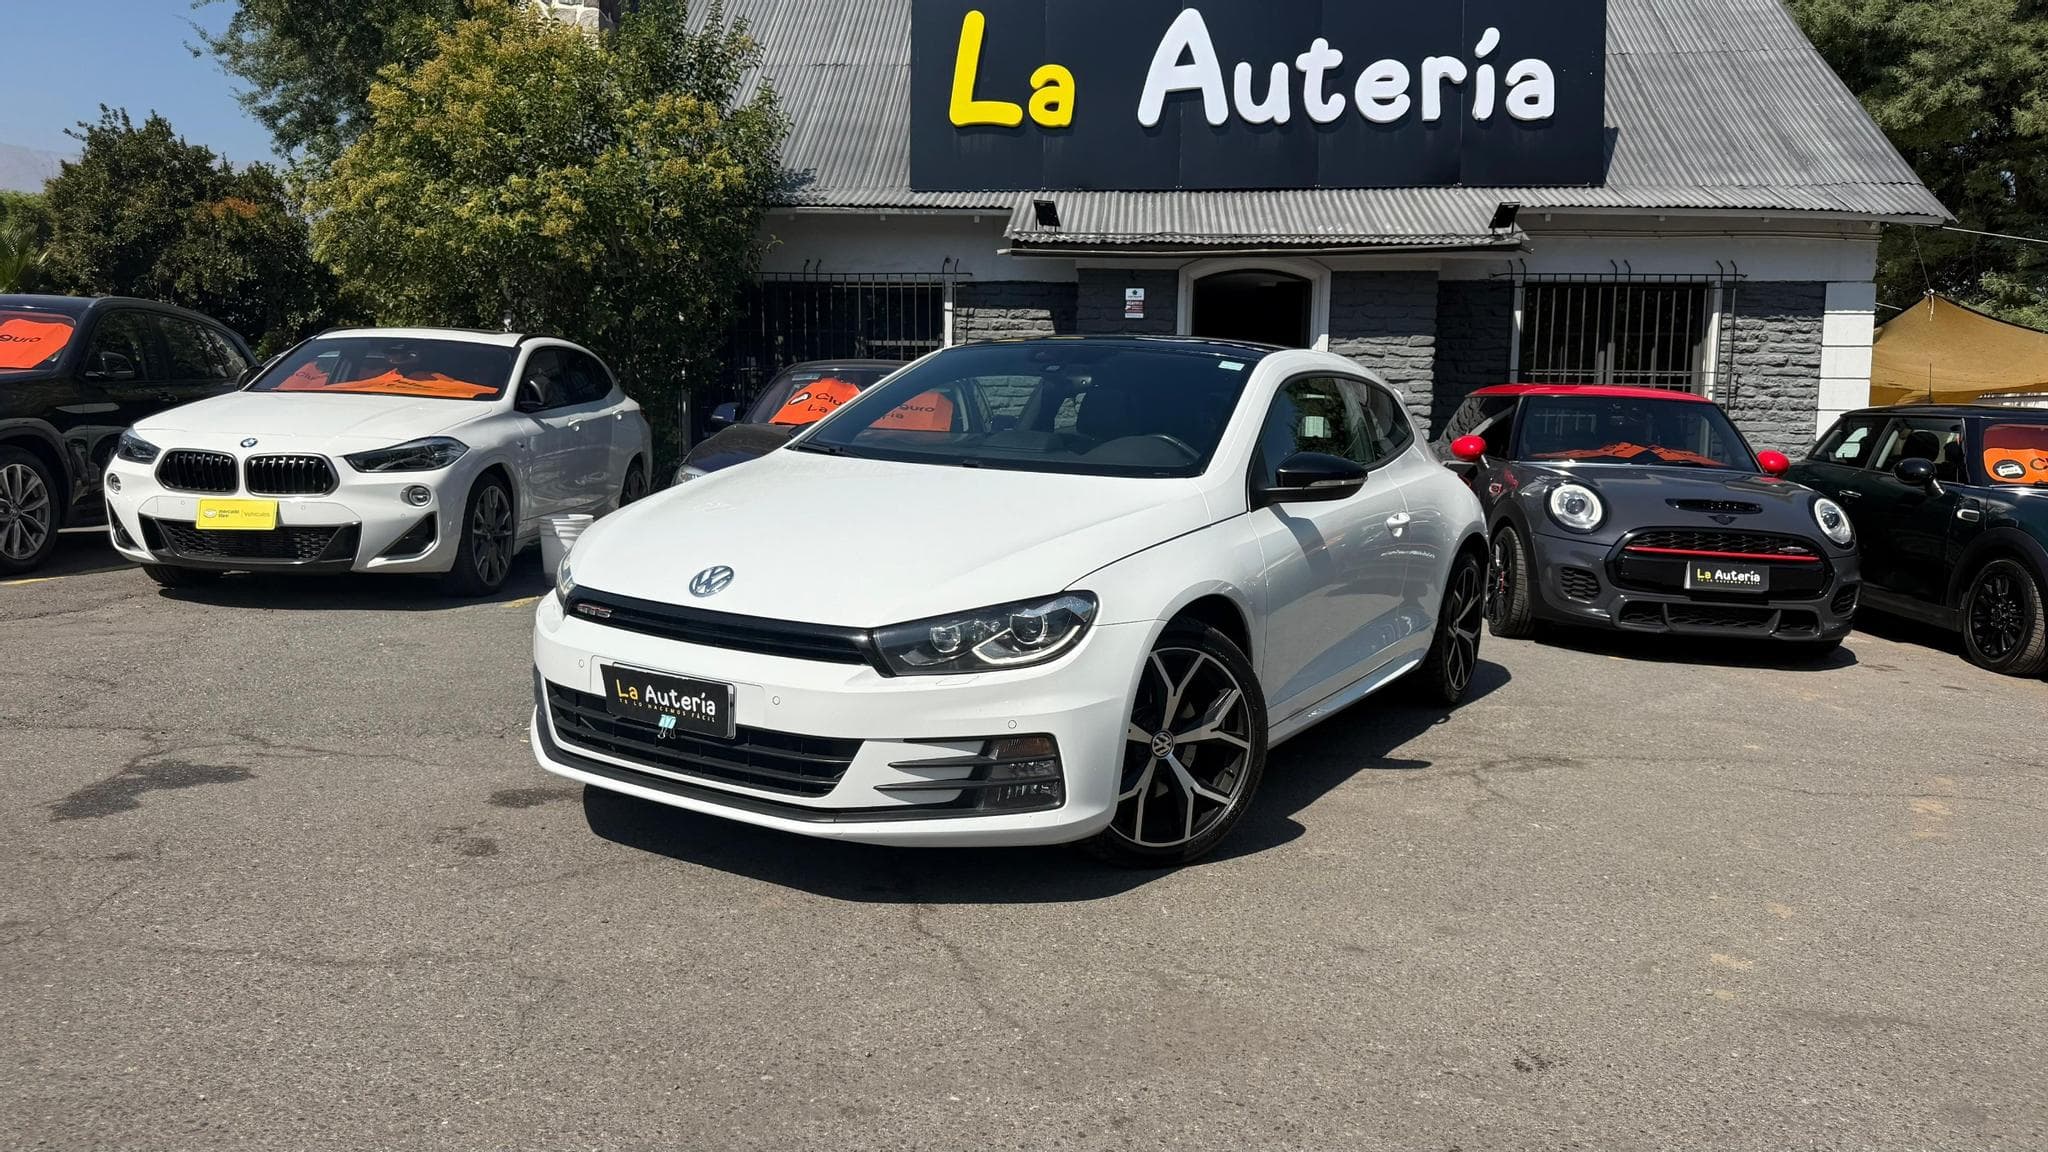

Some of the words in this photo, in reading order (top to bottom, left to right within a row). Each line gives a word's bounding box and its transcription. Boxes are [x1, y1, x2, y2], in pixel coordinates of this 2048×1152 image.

[949, 10, 1076, 128] La
[1137, 8, 1556, 127] Autería
[1696, 567, 1712, 580] La
[1714, 569, 1761, 582] Autería
[616, 679, 639, 701] La
[645, 684, 716, 716] Autería
[647, 704, 687, 717] HACEMOS
